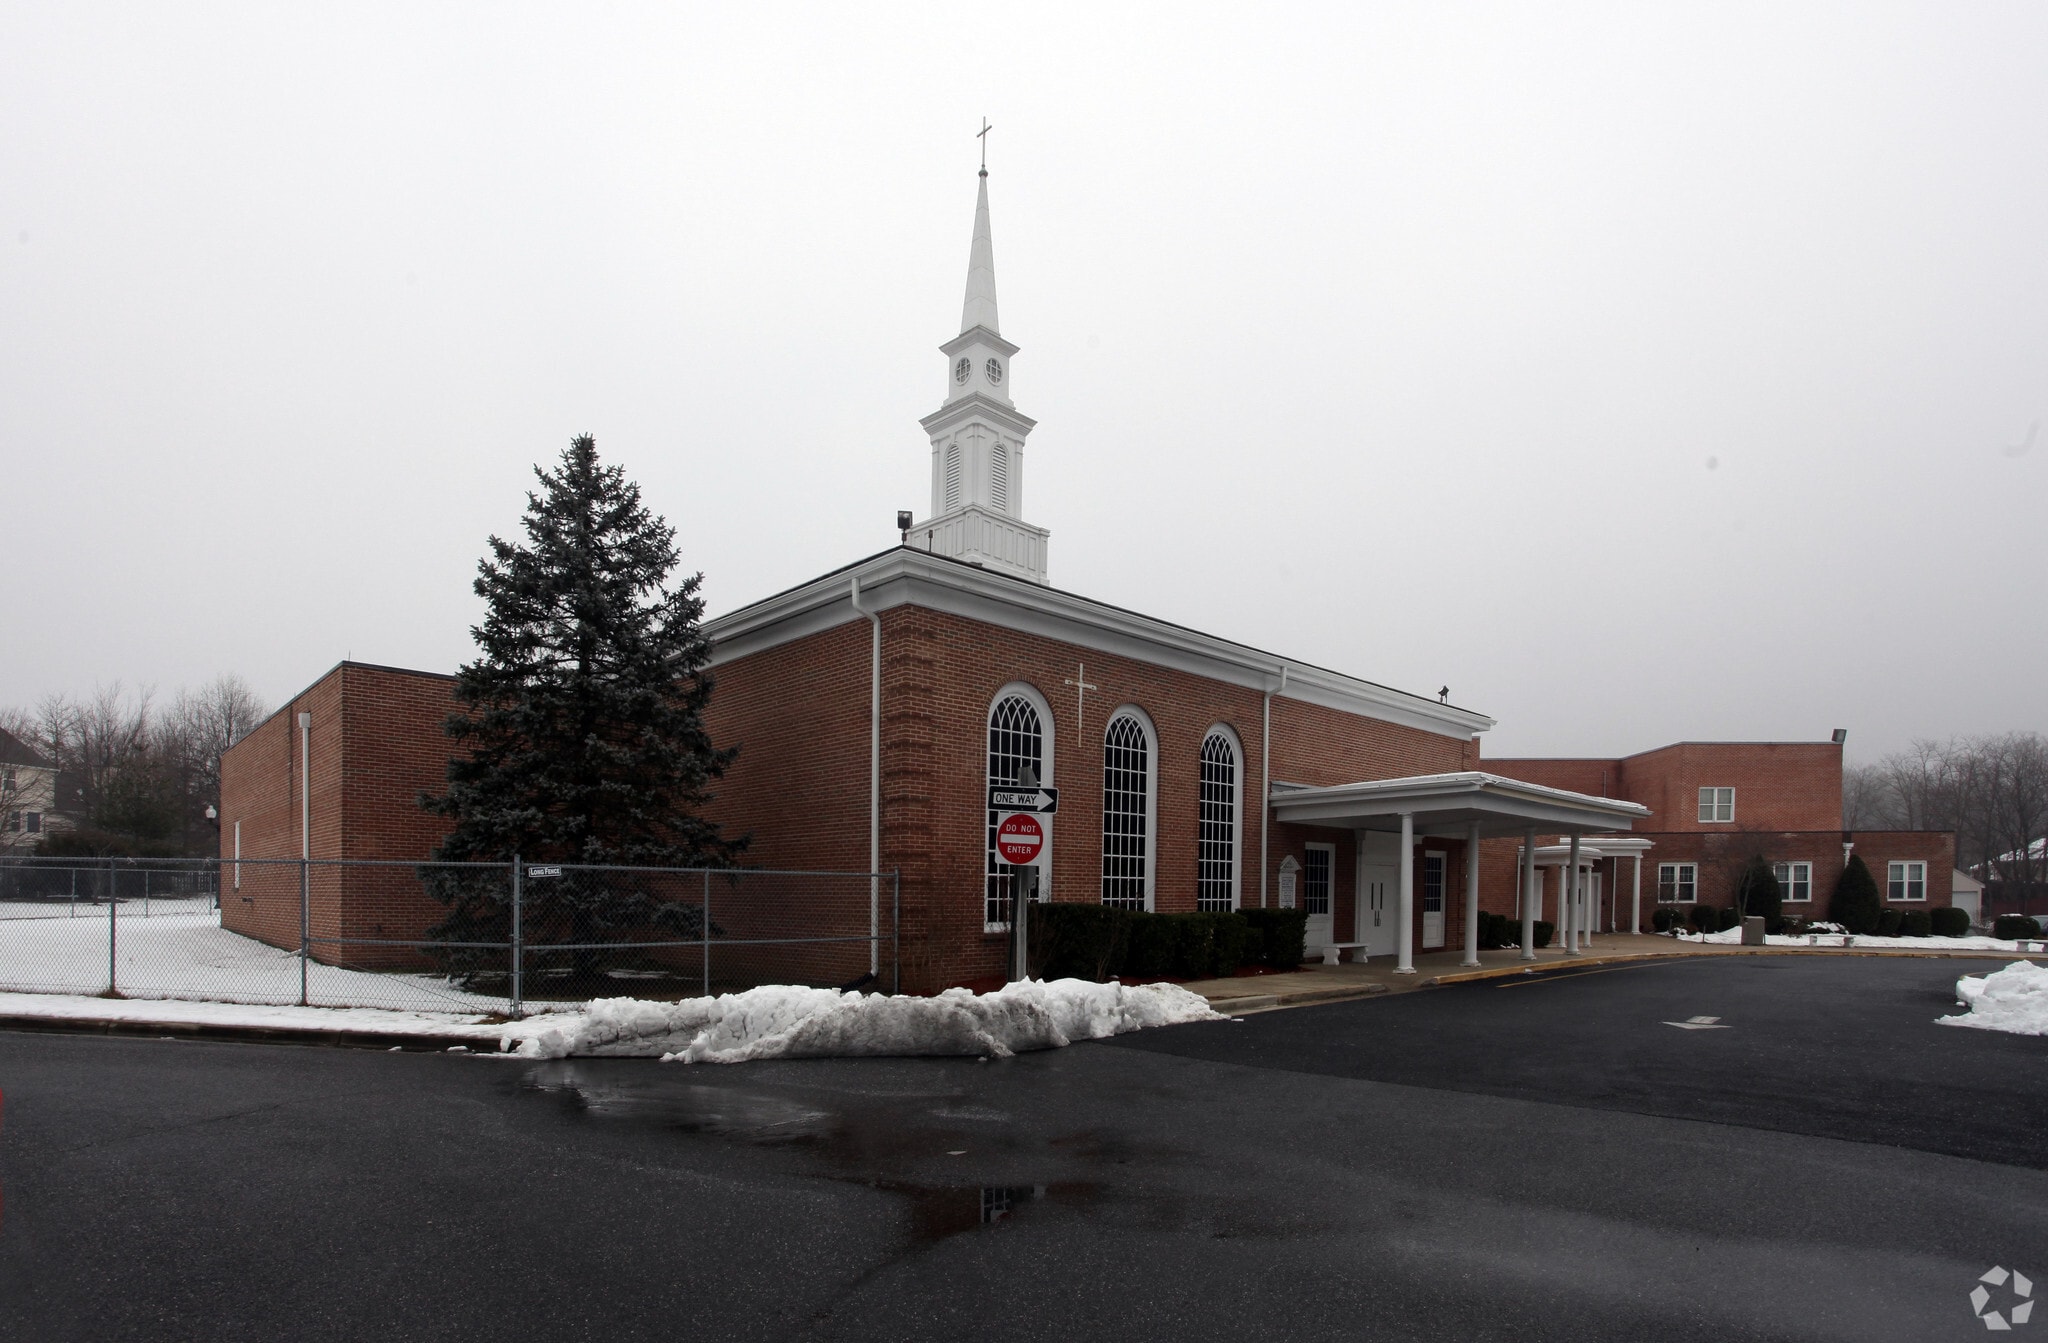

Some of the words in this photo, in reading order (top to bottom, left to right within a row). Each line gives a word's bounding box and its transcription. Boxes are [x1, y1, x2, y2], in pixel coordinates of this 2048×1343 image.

[995, 793, 1014, 803] ONE
[1018, 794, 1037, 804] WAY
[1006, 824, 1017, 832] DO
[1021, 825, 1036, 833] NOT
[1007, 845, 1031, 854] ENTER
